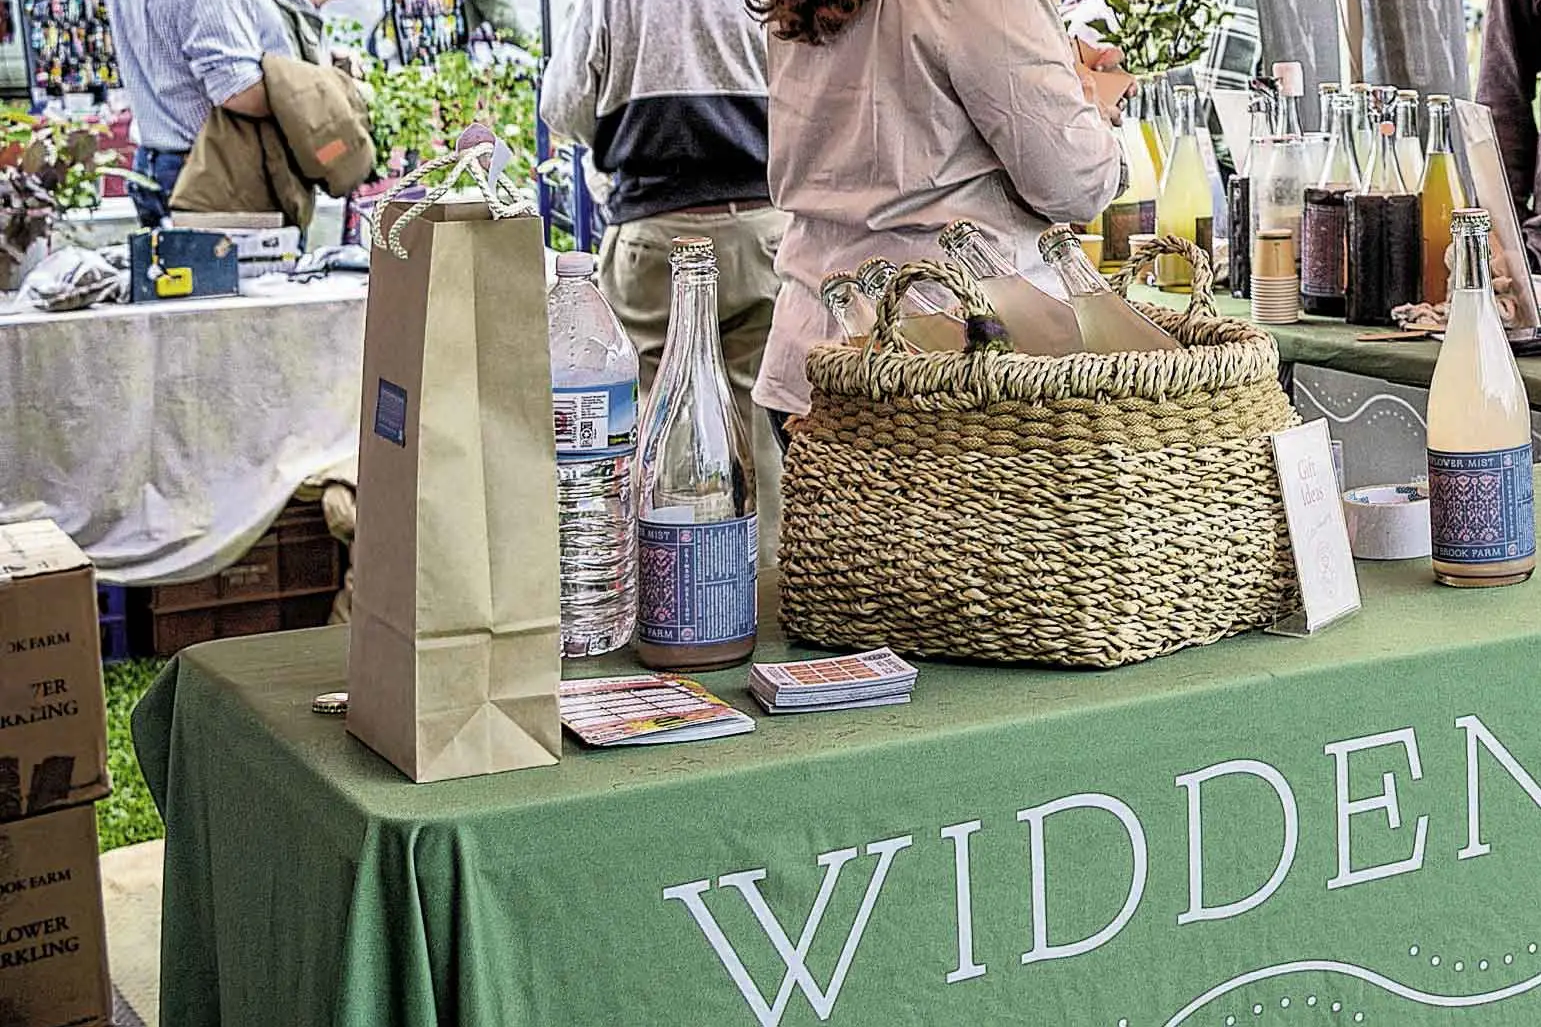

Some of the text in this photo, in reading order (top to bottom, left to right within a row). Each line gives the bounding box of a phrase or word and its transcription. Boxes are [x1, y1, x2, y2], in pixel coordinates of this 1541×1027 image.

[1297, 456, 1317, 480] Gift
[1468, 458, 1494, 468] MIST
[1301, 483, 1325, 506] Ideas
[647, 531, 671, 541] MIST
[1472, 547, 1501, 558] FARM
[29, 631, 71, 650] FARM
[647, 627, 673, 640] FARM
[29, 869, 72, 888] FARM
[0, 936, 80, 970] RKLING
